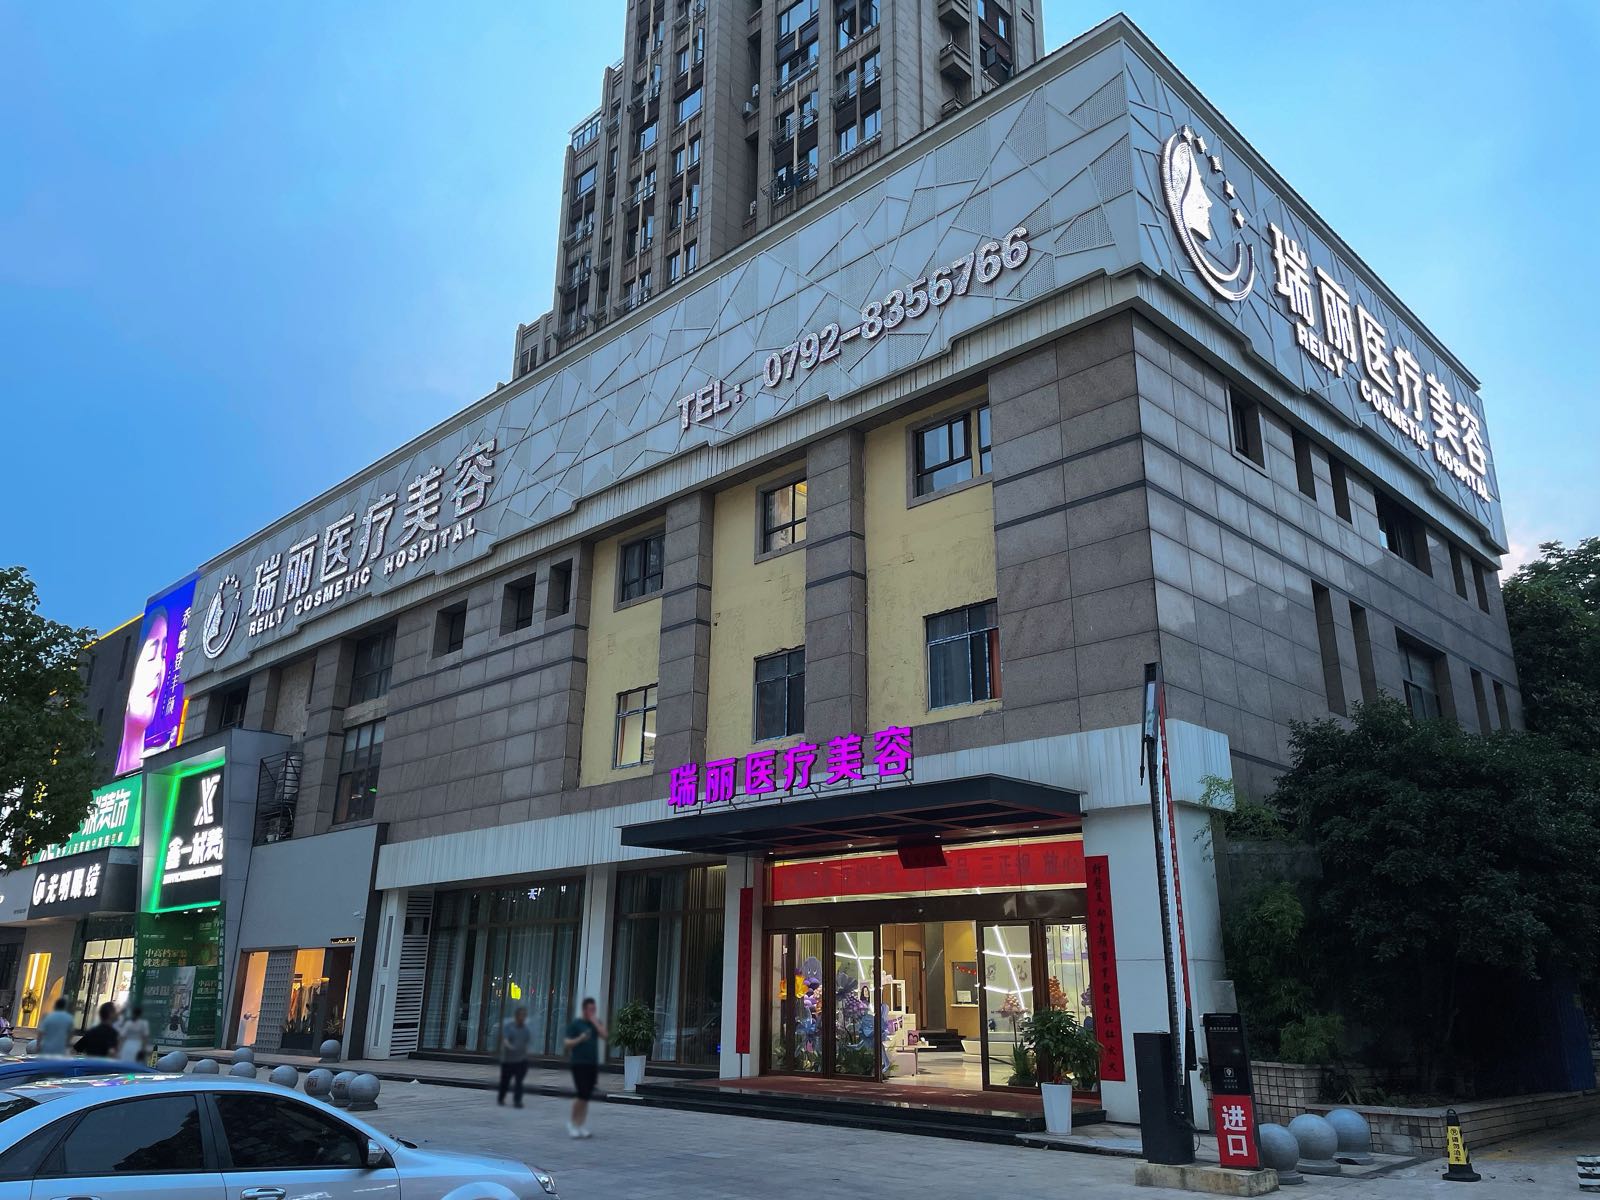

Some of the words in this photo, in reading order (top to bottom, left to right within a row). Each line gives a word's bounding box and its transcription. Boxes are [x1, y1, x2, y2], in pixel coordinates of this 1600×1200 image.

[762, 226, 1030, 388] 0792-8356766
[1268, 222, 1487, 476] 瑞丽医疗美容
[1296, 322, 1344, 378] REILY
[1359, 379, 1429, 451] COSMETIC
[1435, 440, 1492, 502] HOSPITAL
[248, 438, 497, 617] 瑞丽医疗美容
[248, 606, 286, 637] REILY
[294, 566, 372, 615] COSMETIC
[383, 517, 476, 576] HOSPITAL
[668, 725, 913, 809] 瑞丽医疗美容
[45, 863, 101, 904] 光明眼镜
[1222, 1105, 1248, 1157] 进口
